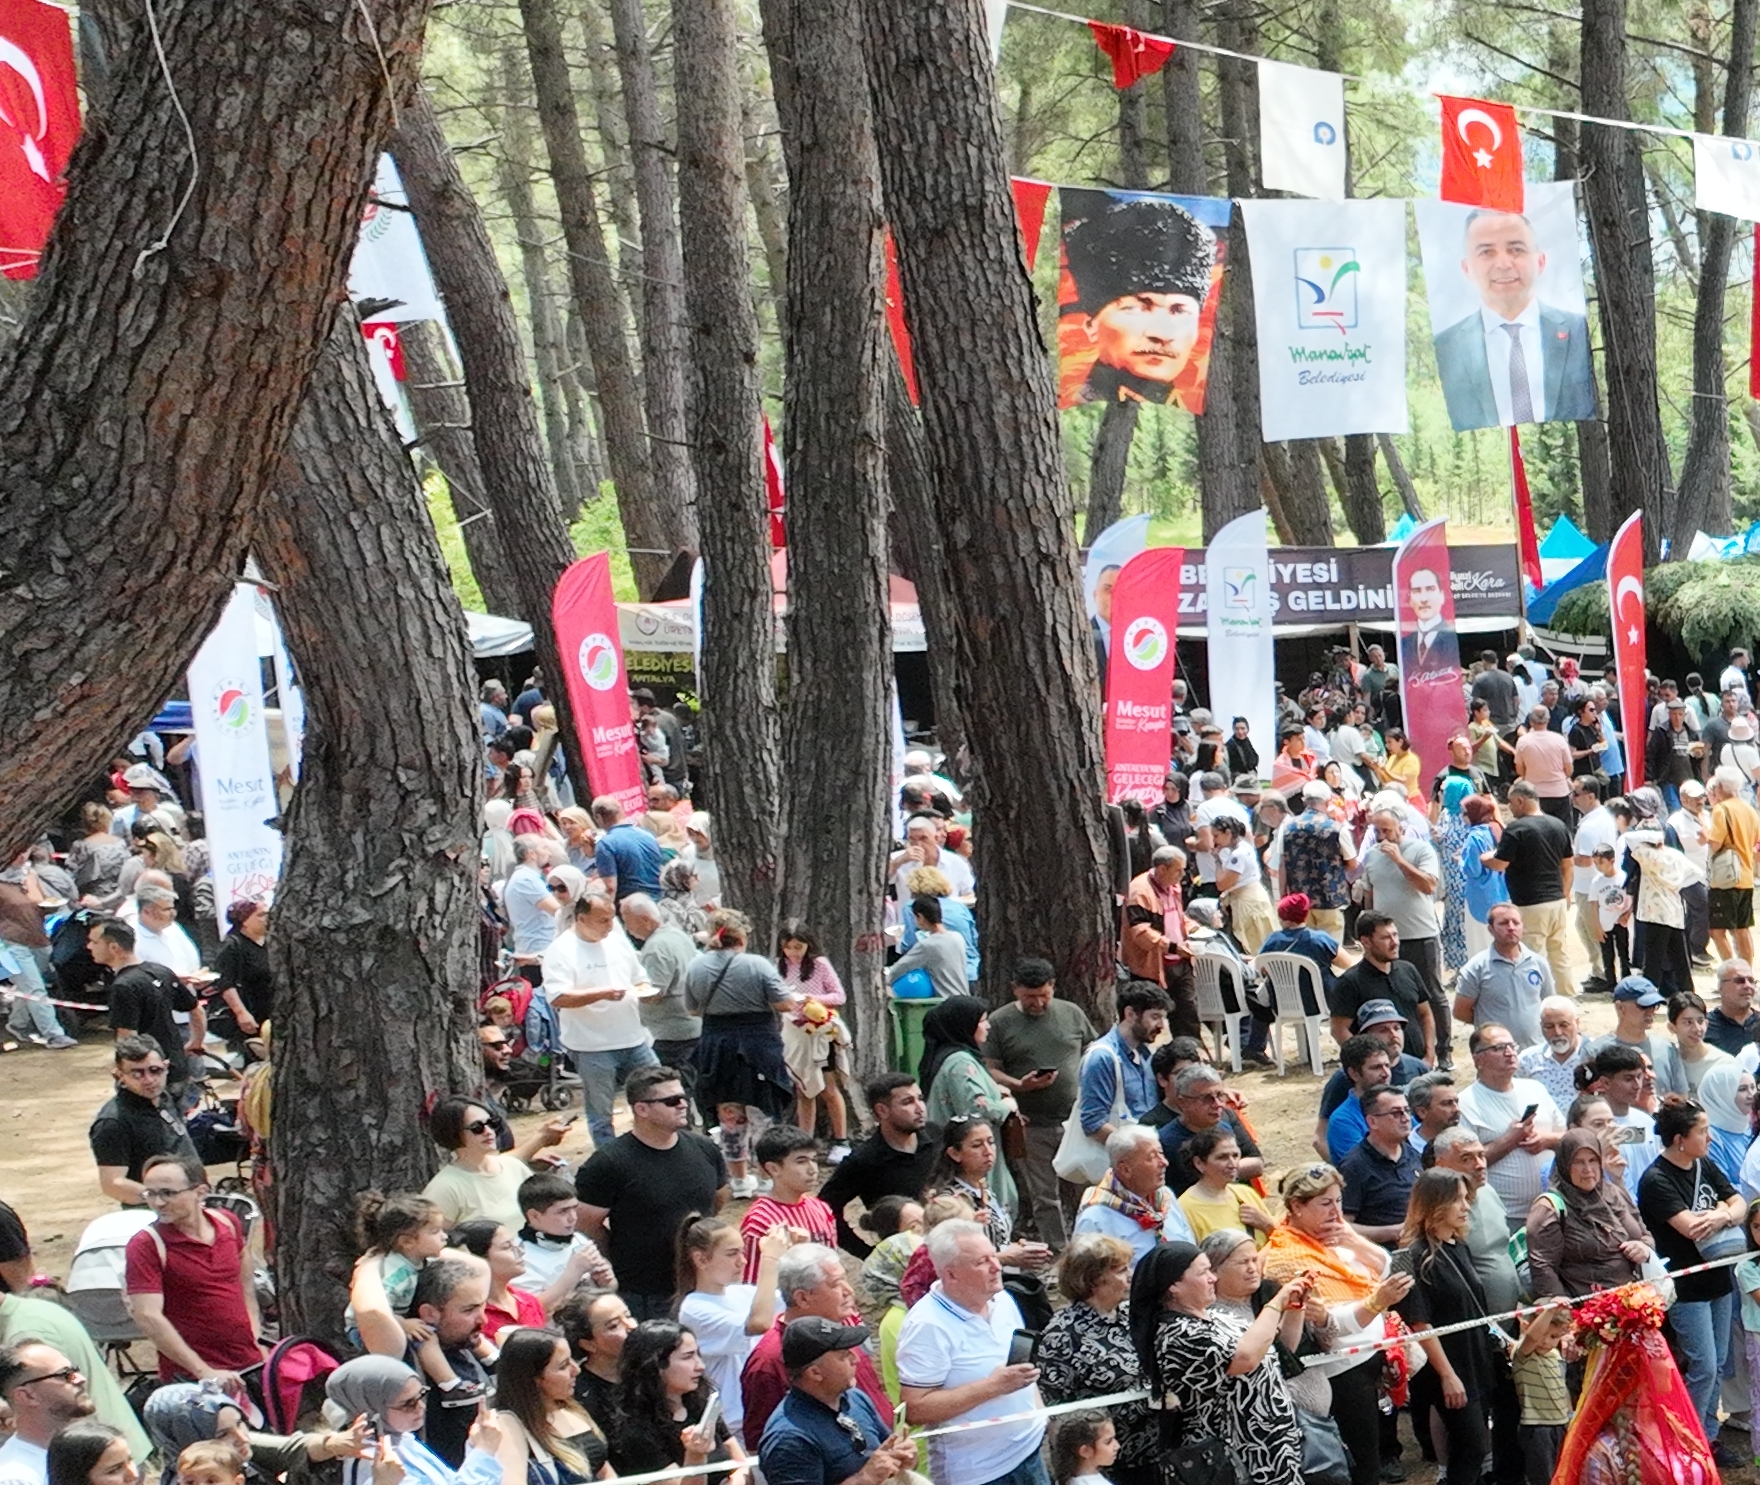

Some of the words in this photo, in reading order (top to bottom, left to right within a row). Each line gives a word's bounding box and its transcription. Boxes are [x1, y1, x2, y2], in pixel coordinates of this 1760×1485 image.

[1298, 370, 1366, 387] Belediyesi
[1179, 557, 1339, 586] BEİYESİ
[1287, 584, 1395, 612] GELDİNİ
[625, 656, 694, 673] ELEDİYESİ
[1116, 700, 1167, 718] Mesut
[592, 722, 633, 744] Mesut
